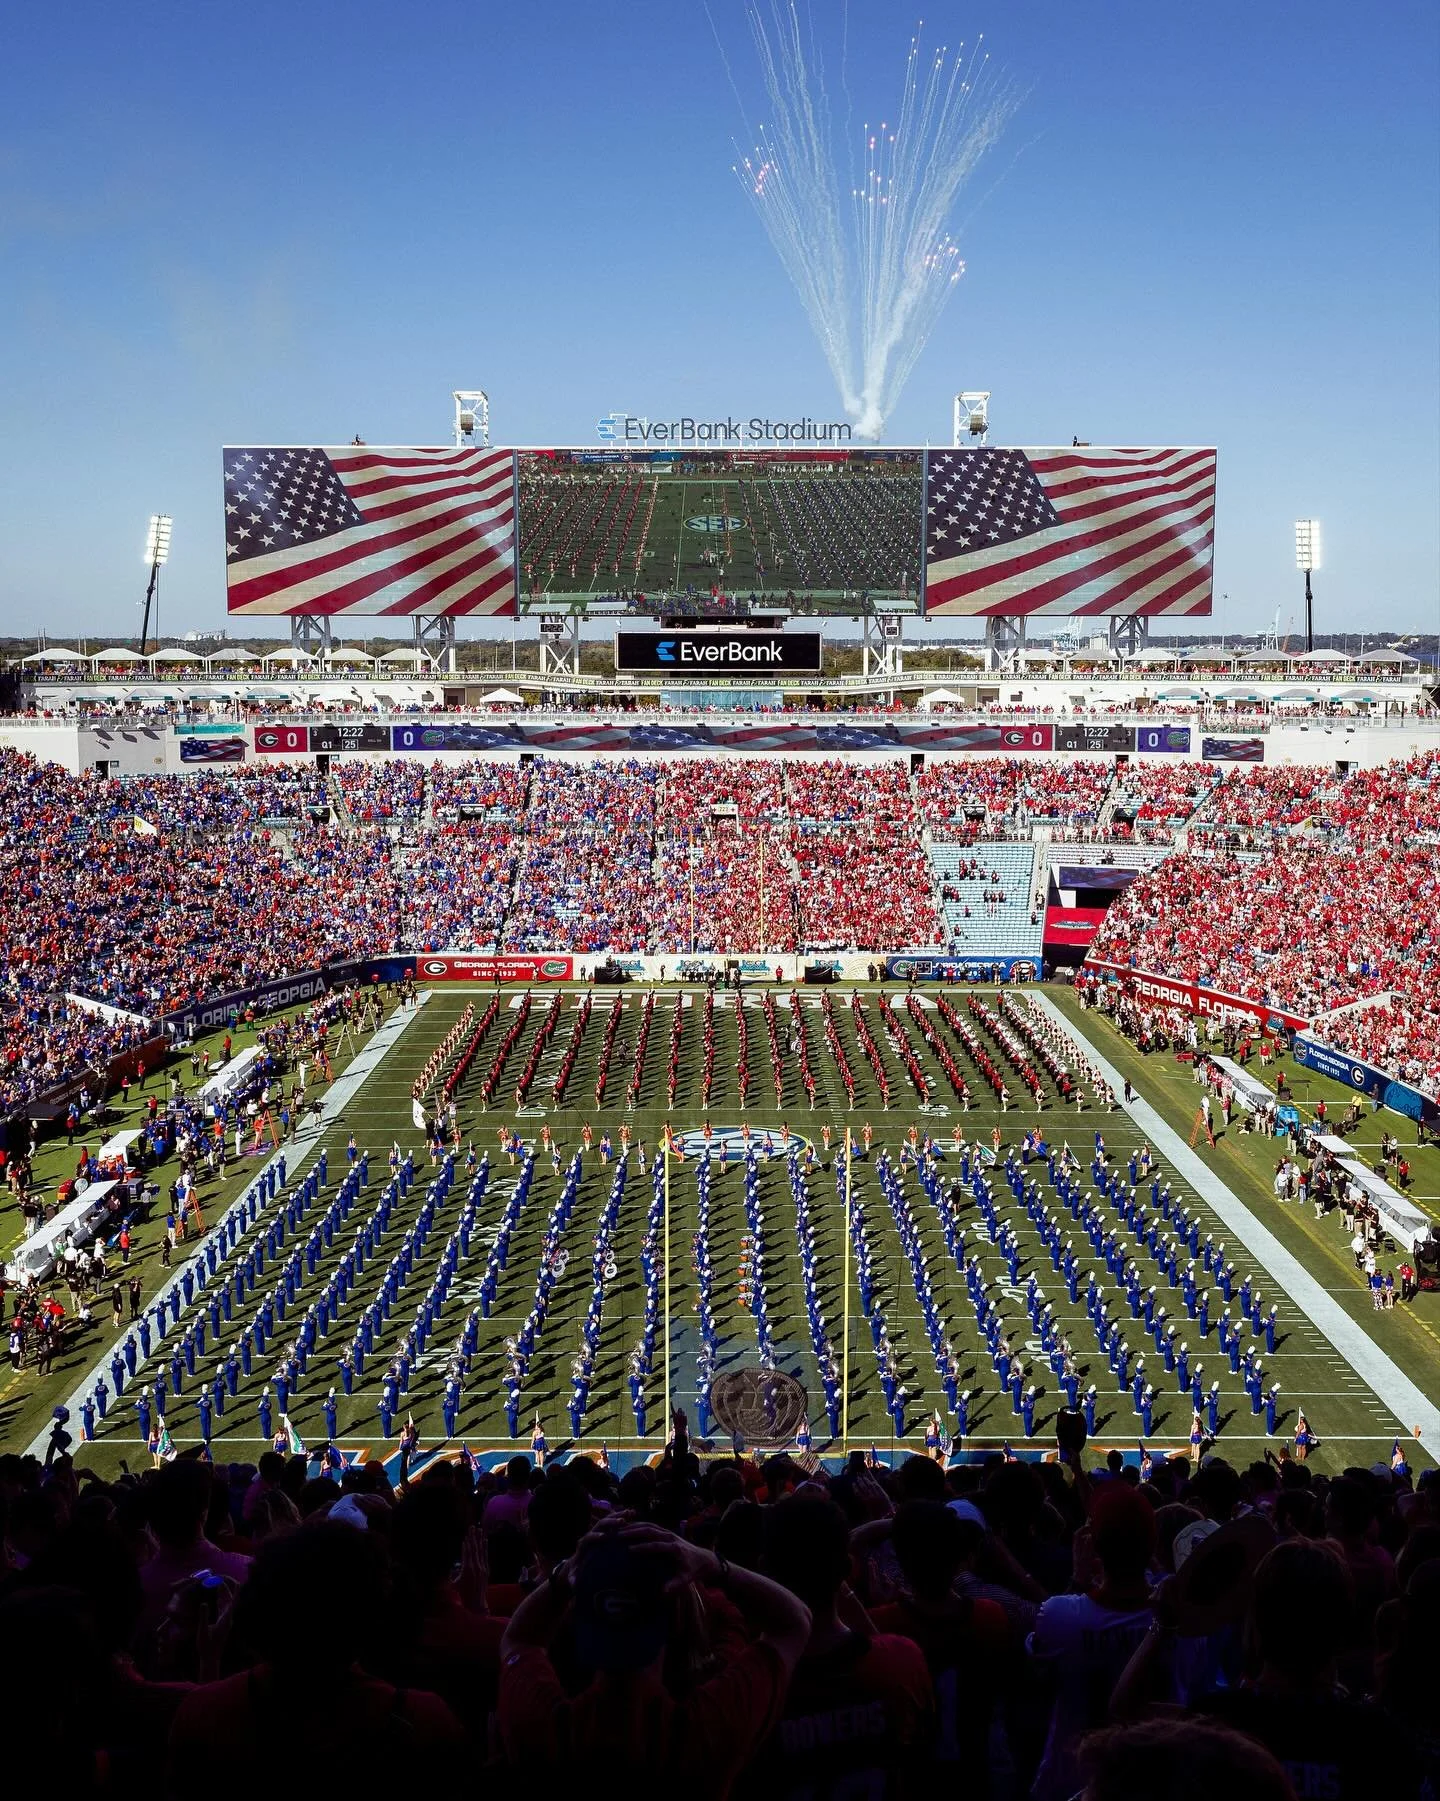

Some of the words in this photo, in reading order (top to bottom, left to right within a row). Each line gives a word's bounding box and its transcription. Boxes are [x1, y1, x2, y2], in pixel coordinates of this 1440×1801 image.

[625, 417, 741, 440] EverBank
[748, 417, 852, 440] Stadium
[681, 640, 783, 662] EverBank
[287, 732, 298, 747] 0
[337, 727, 364, 737] 12:22
[403, 731, 414, 746] 0
[1032, 731, 1043, 746] 0
[1083, 728, 1109, 737] 12:22
[1148, 732, 1159, 747] 0
[321, 741, 332, 749] Q1
[344, 740, 356, 749] 25
[1066, 741, 1077, 749] Q1
[1089, 740, 1101, 749] 25
[1131, 976, 1194, 1008] GEORGIA
[779, 1699, 887, 1755] BOWERS
